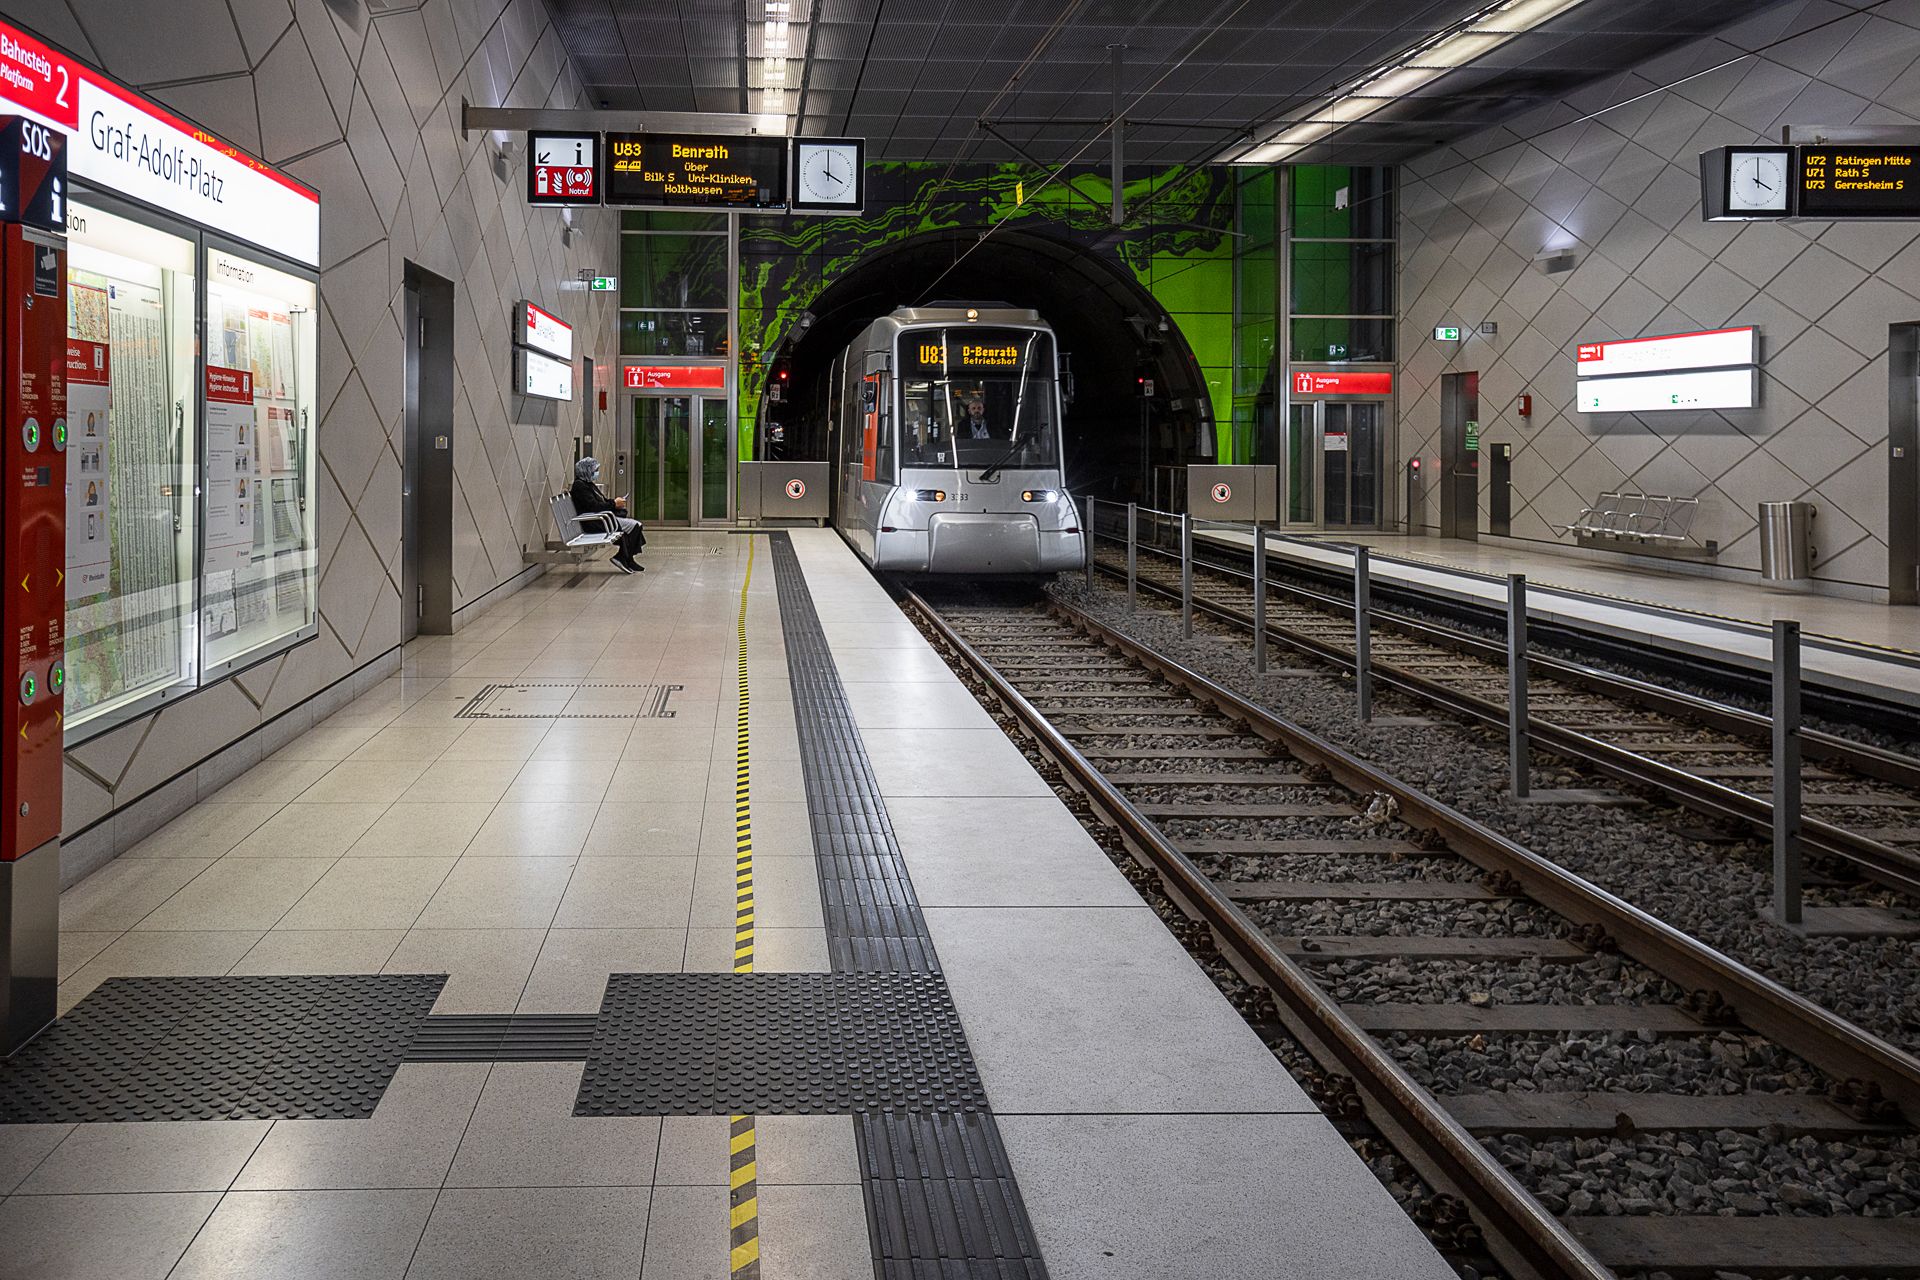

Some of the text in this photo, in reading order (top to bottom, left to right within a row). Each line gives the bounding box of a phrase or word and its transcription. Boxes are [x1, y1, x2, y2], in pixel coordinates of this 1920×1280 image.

[1, 32, 69, 108] Bahnsteig 2
[0, 62, 34, 91] Platform
[22, 119, 51, 161] SOS
[614, 143, 729, 159] U83 Benrath
[91, 110, 223, 204] Graf-Adolf-Platz
[1806, 155, 1911, 167] U72 Ratingen Mitte
[1806, 168, 1870, 177] U71 Rath S
[644, 173, 752, 184] Bilk S Uni-Kliniken
[664, 184, 723, 194] Holthausen
[1805, 180, 1904, 189] U73 Gerresheim S
[568, 187, 590, 195] Notruf
[216, 258, 254, 283] Information
[919, 345, 1018, 364] U83 D-Benrath
[963, 357, 1017, 365] Betriebshof
[647, 371, 671, 379] Ausgang
[1315, 377, 1340, 385] Ausgang
